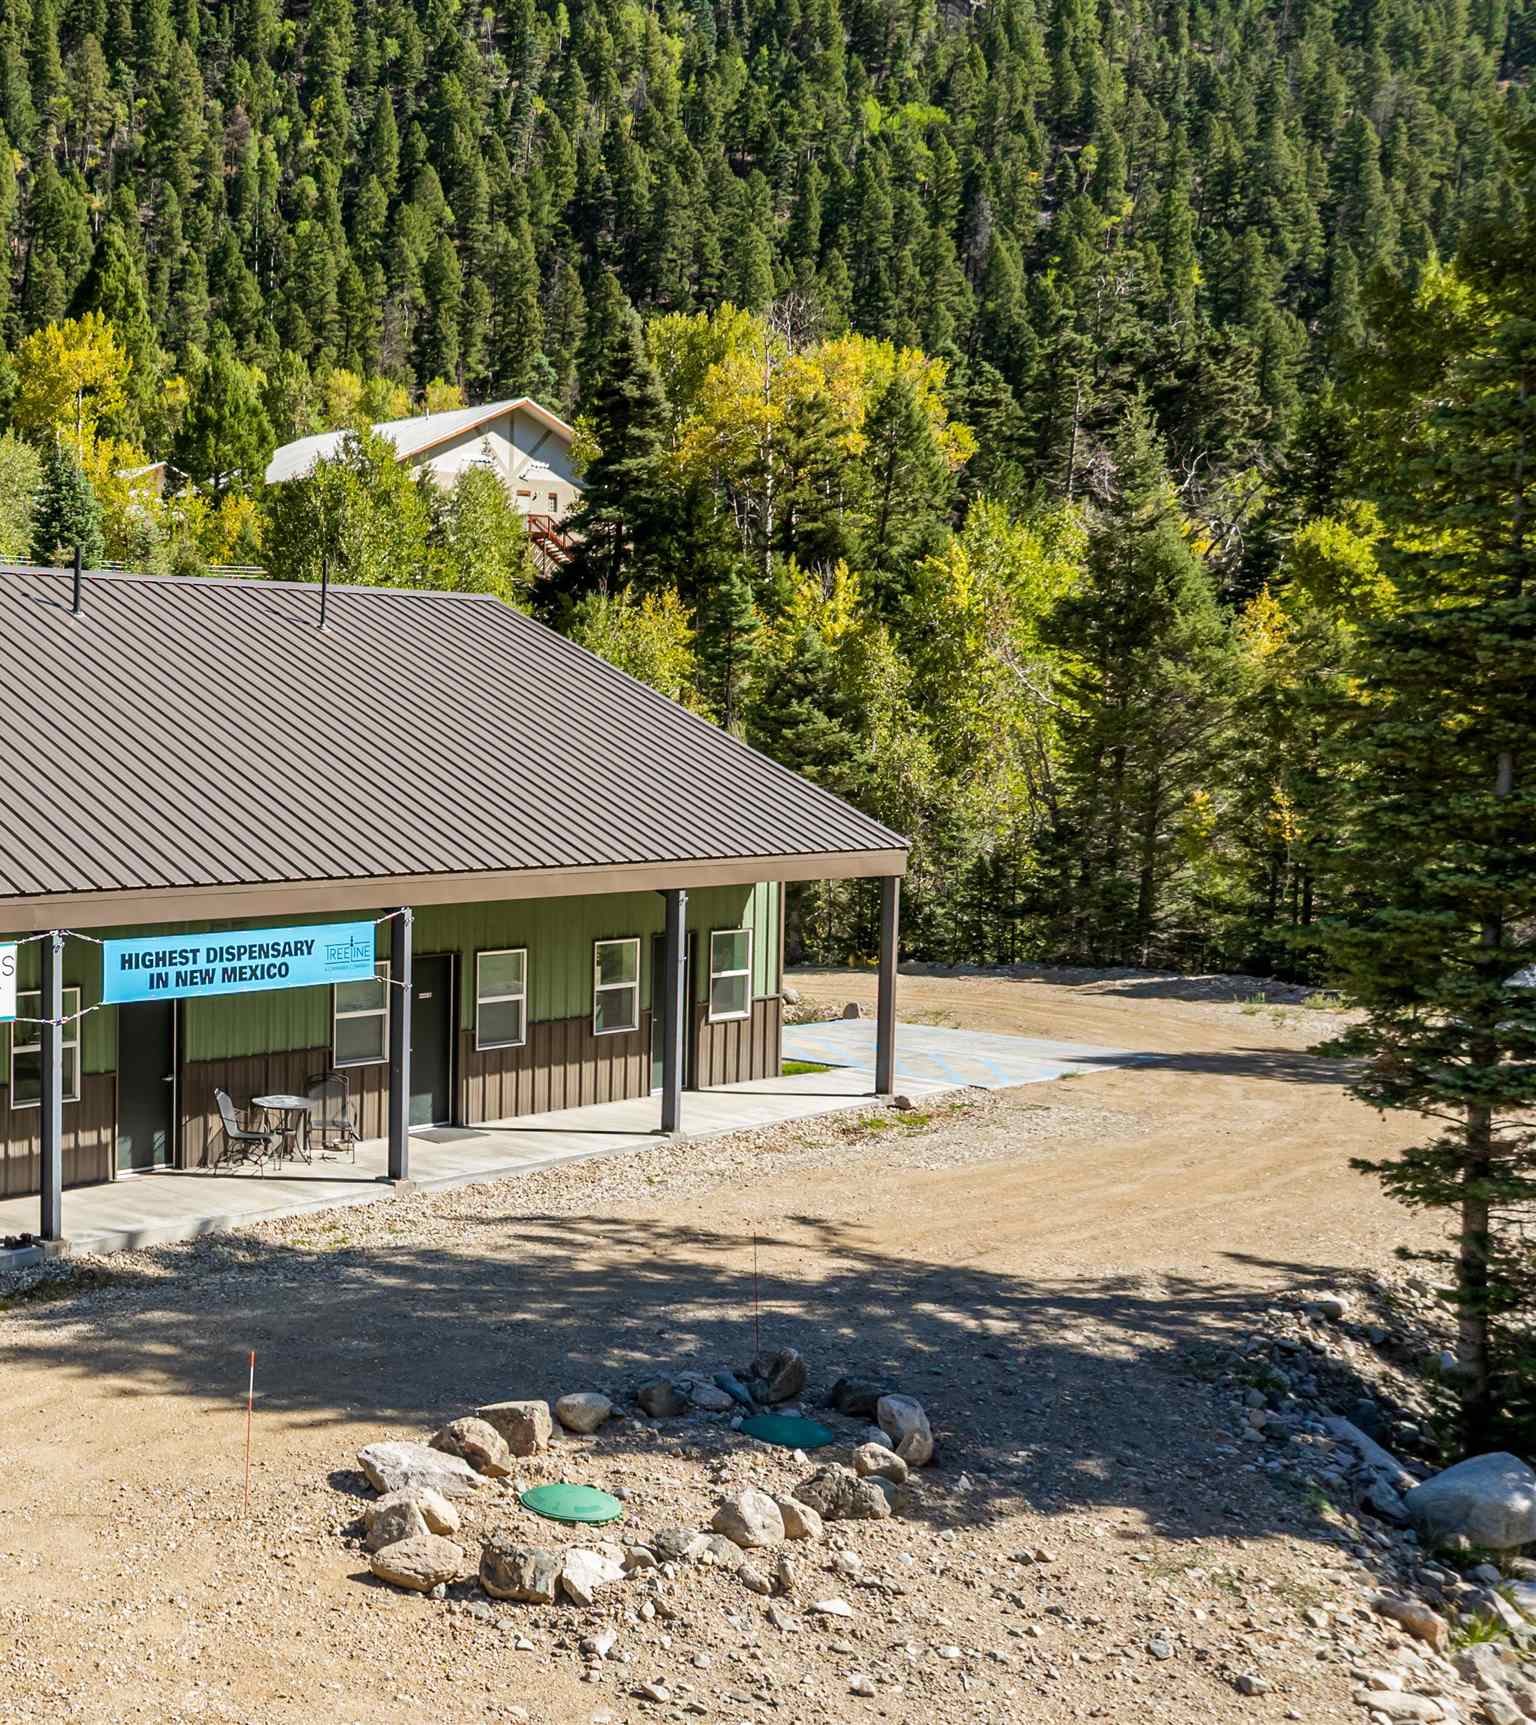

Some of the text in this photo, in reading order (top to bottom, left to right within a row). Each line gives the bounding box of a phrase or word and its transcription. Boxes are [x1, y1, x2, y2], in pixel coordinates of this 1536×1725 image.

[120, 939, 315, 970] HIGHEST DISPENSARY
[324, 941, 371, 965] TREELINE
[149, 962, 290, 990] IN NEW MEXICO
